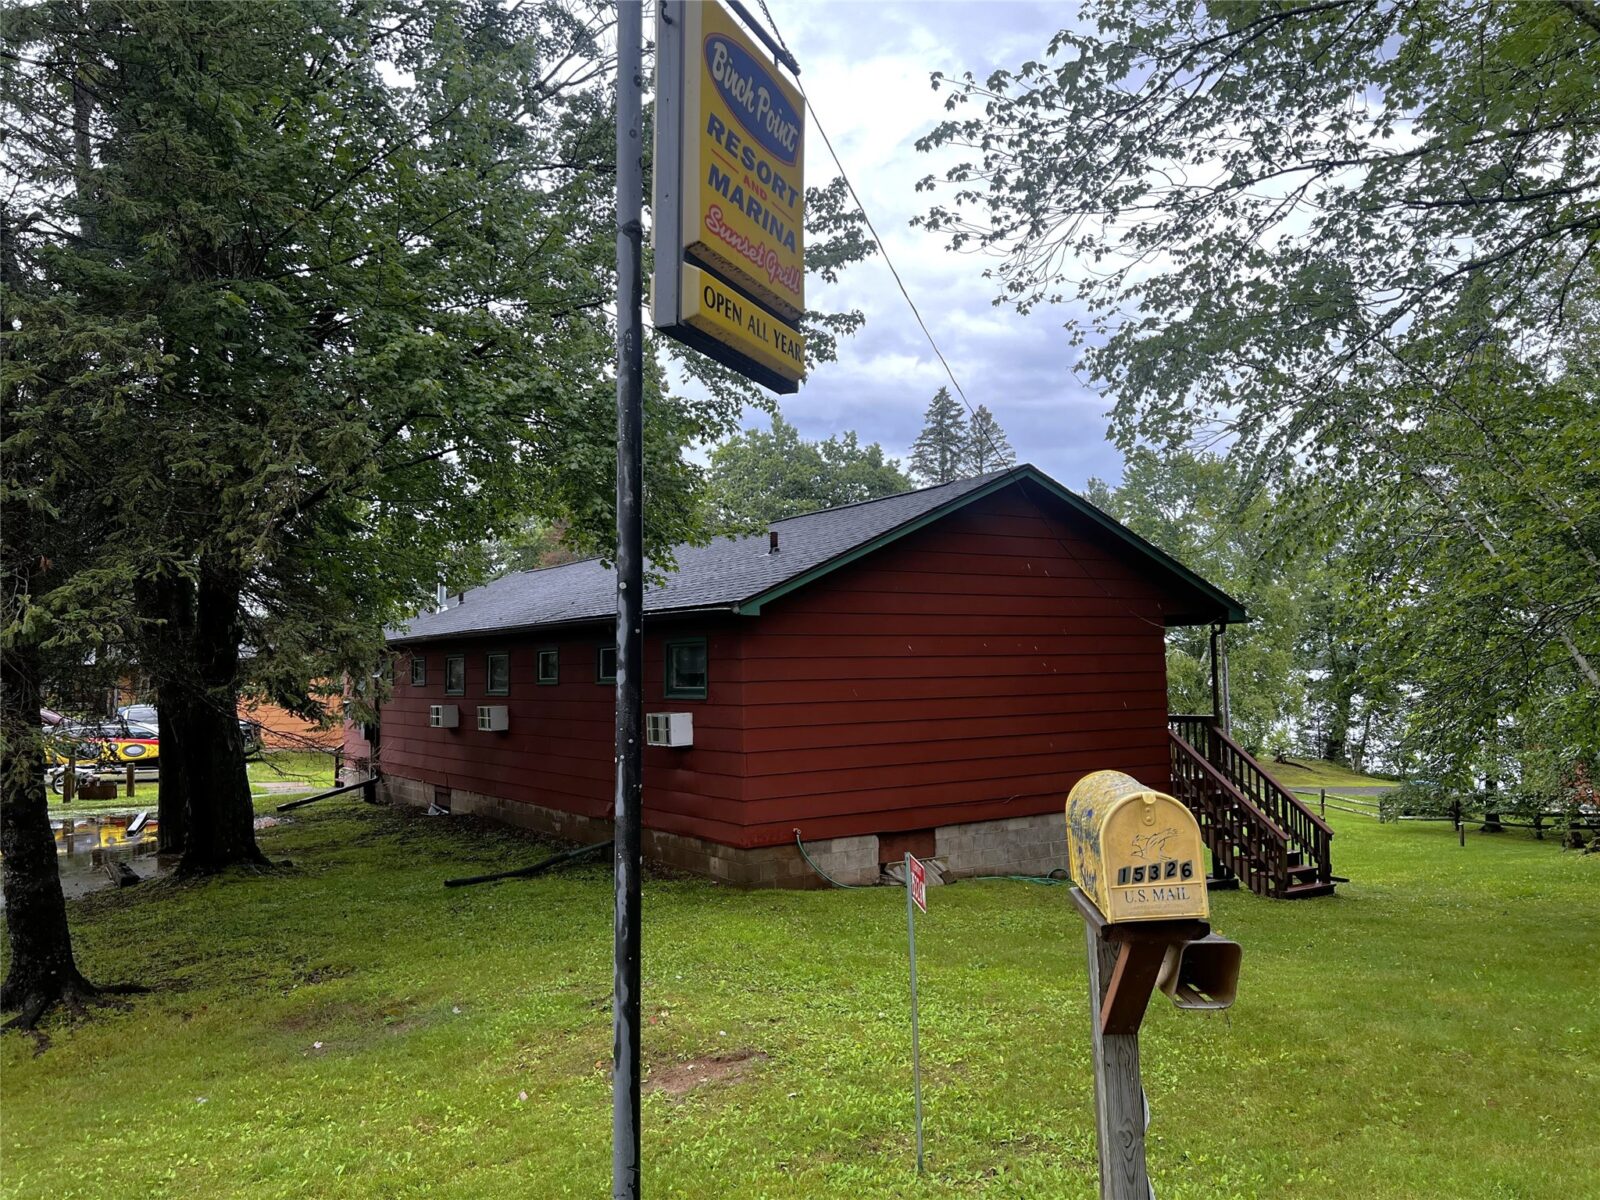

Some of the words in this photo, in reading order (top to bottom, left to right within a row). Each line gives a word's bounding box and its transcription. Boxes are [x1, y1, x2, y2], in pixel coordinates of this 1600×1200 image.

[712, 41, 755, 112] Birch
[756, 86, 799, 153] Point
[706, 112, 799, 208] RESORT
[743, 174, 768, 201] AND
[705, 204, 765, 269] Sunset
[765, 249, 800, 295] Grill
[708, 163, 796, 254] MARINA
[704, 286, 742, 327] OPEN
[747, 313, 769, 343] ALL
[773, 329, 802, 364] YEAR
[1120, 861, 1192, 884] 15326
[1125, 890, 1149, 903] U.S.
[1153, 887, 1191, 901] MAIL
